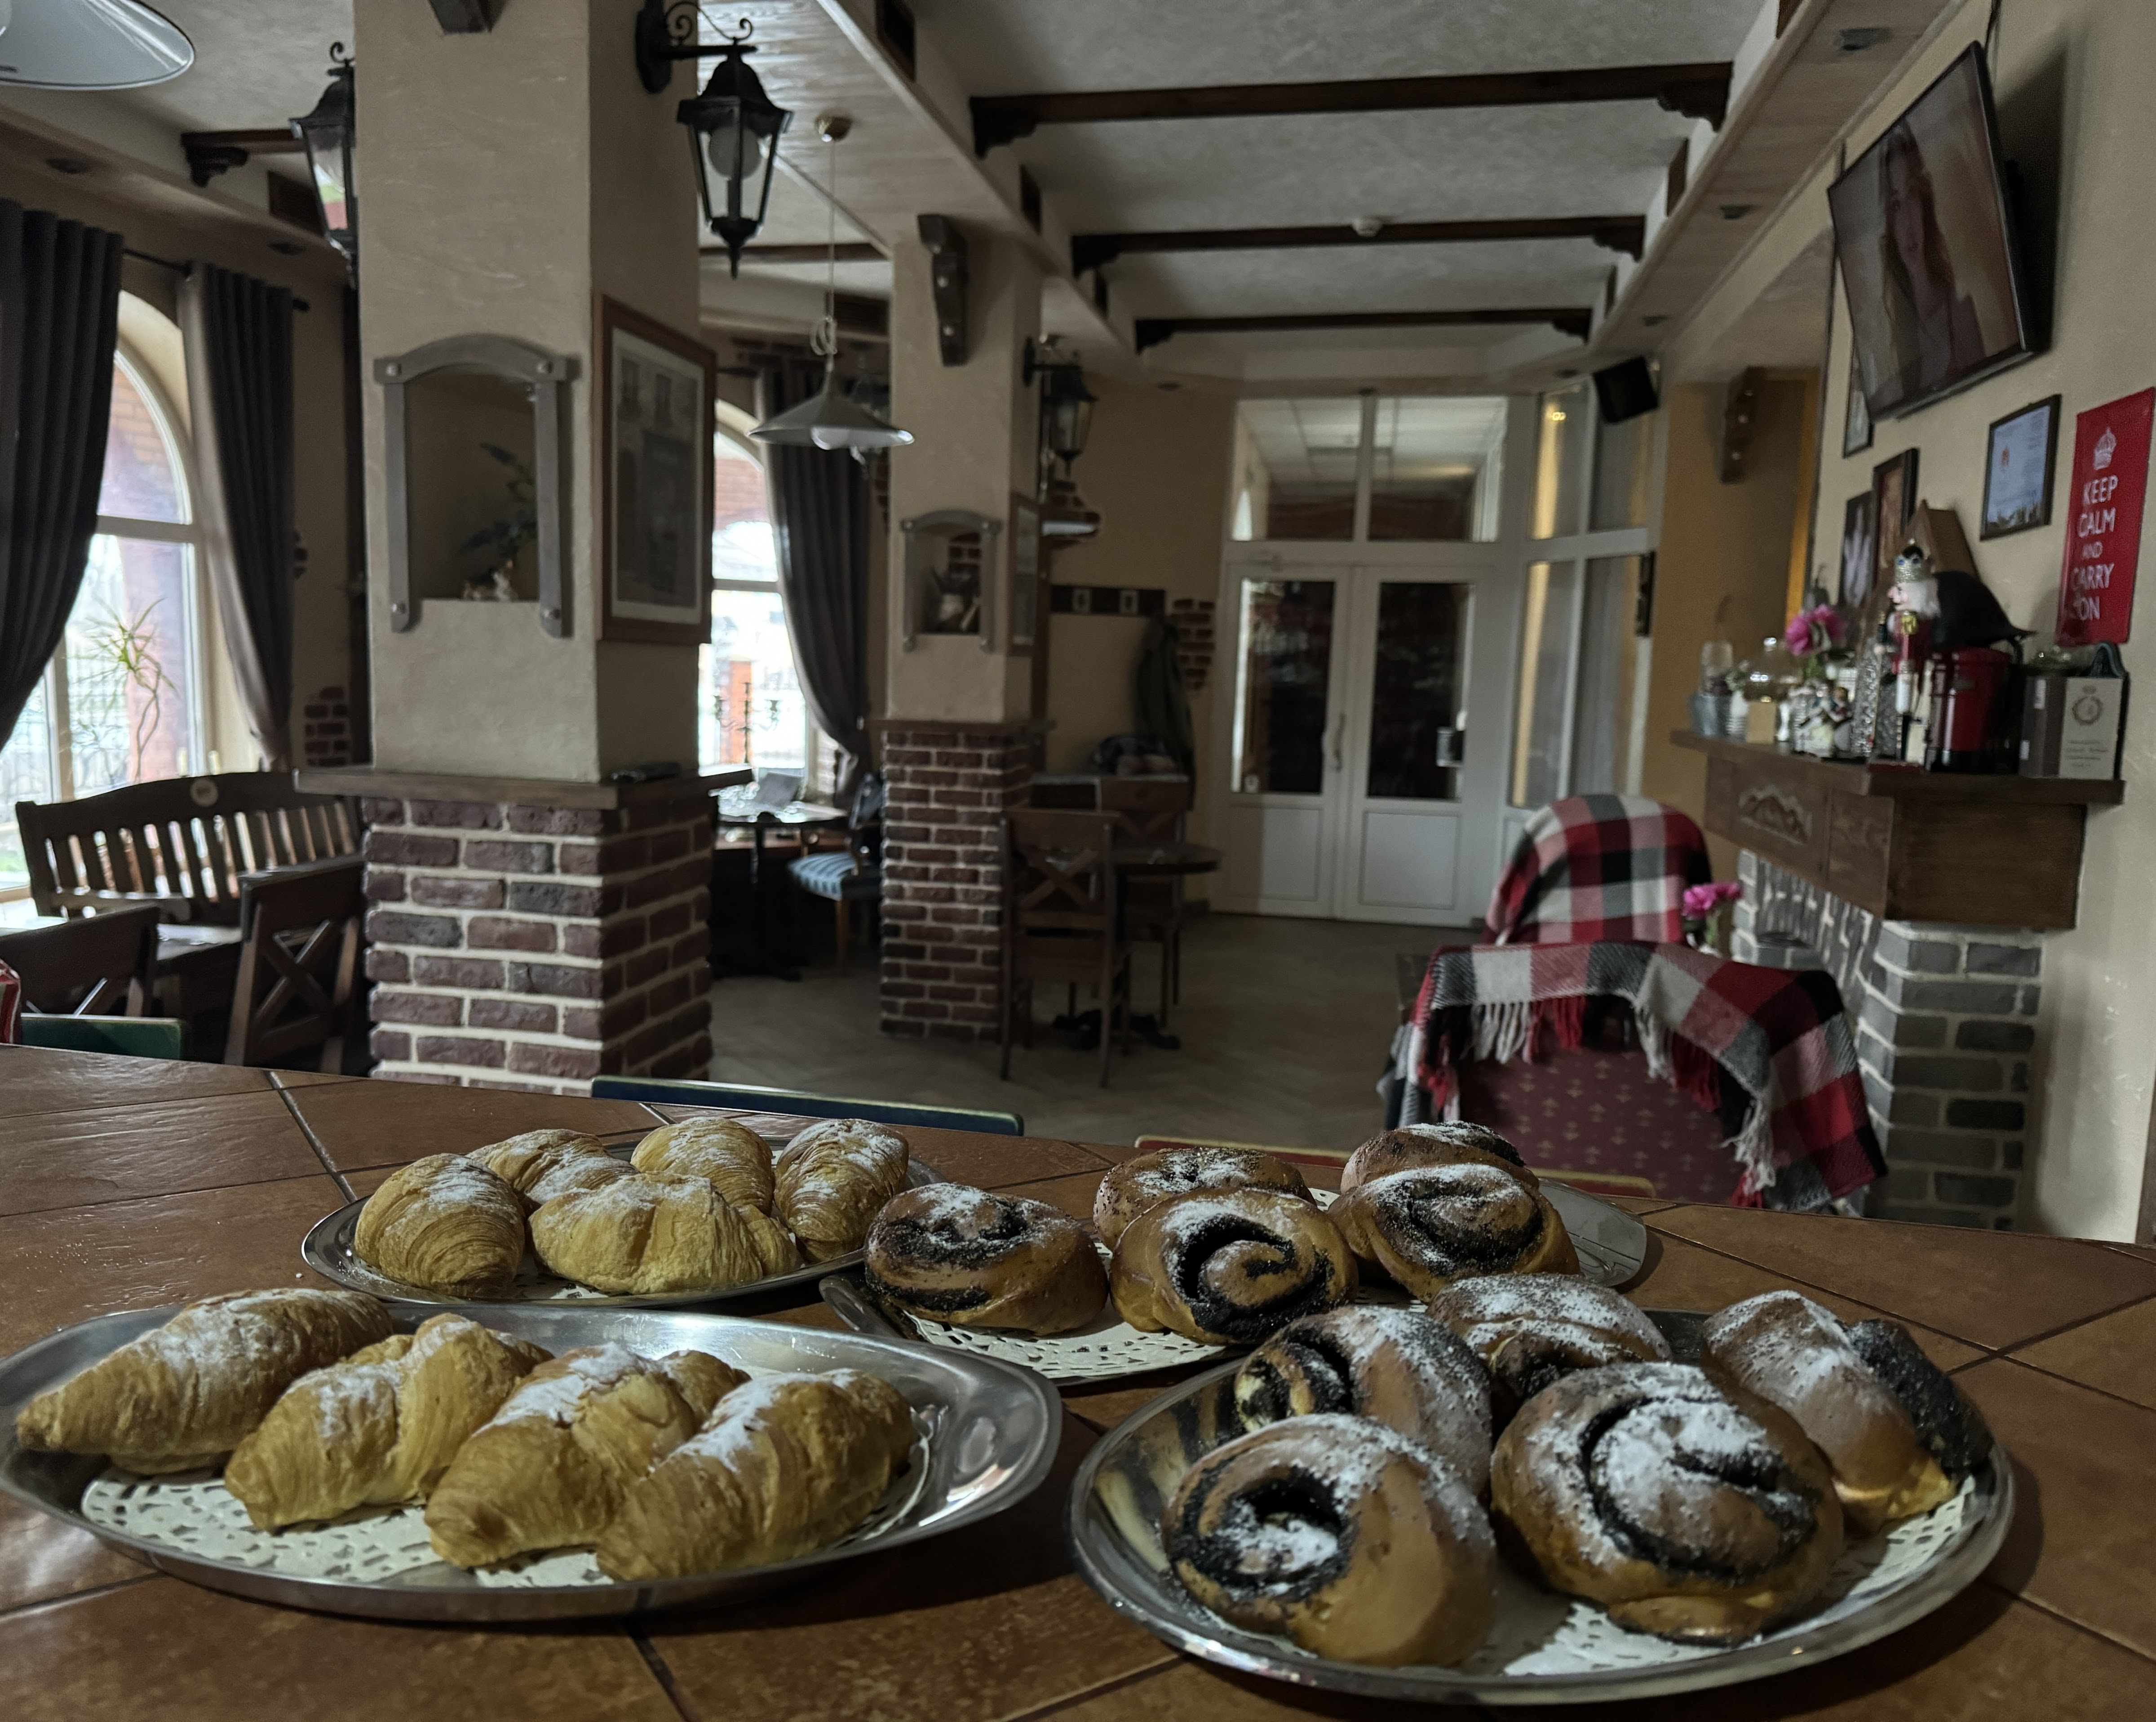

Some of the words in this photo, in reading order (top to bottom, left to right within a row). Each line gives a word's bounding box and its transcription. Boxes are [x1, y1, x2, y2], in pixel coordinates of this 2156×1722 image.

[2083, 475, 2118, 505] KEEP
[2077, 507, 2116, 537] CALM
[2082, 541, 2103, 559] AND
[2070, 563, 2114, 592] CARRY
[2077, 596, 2100, 621] ON
